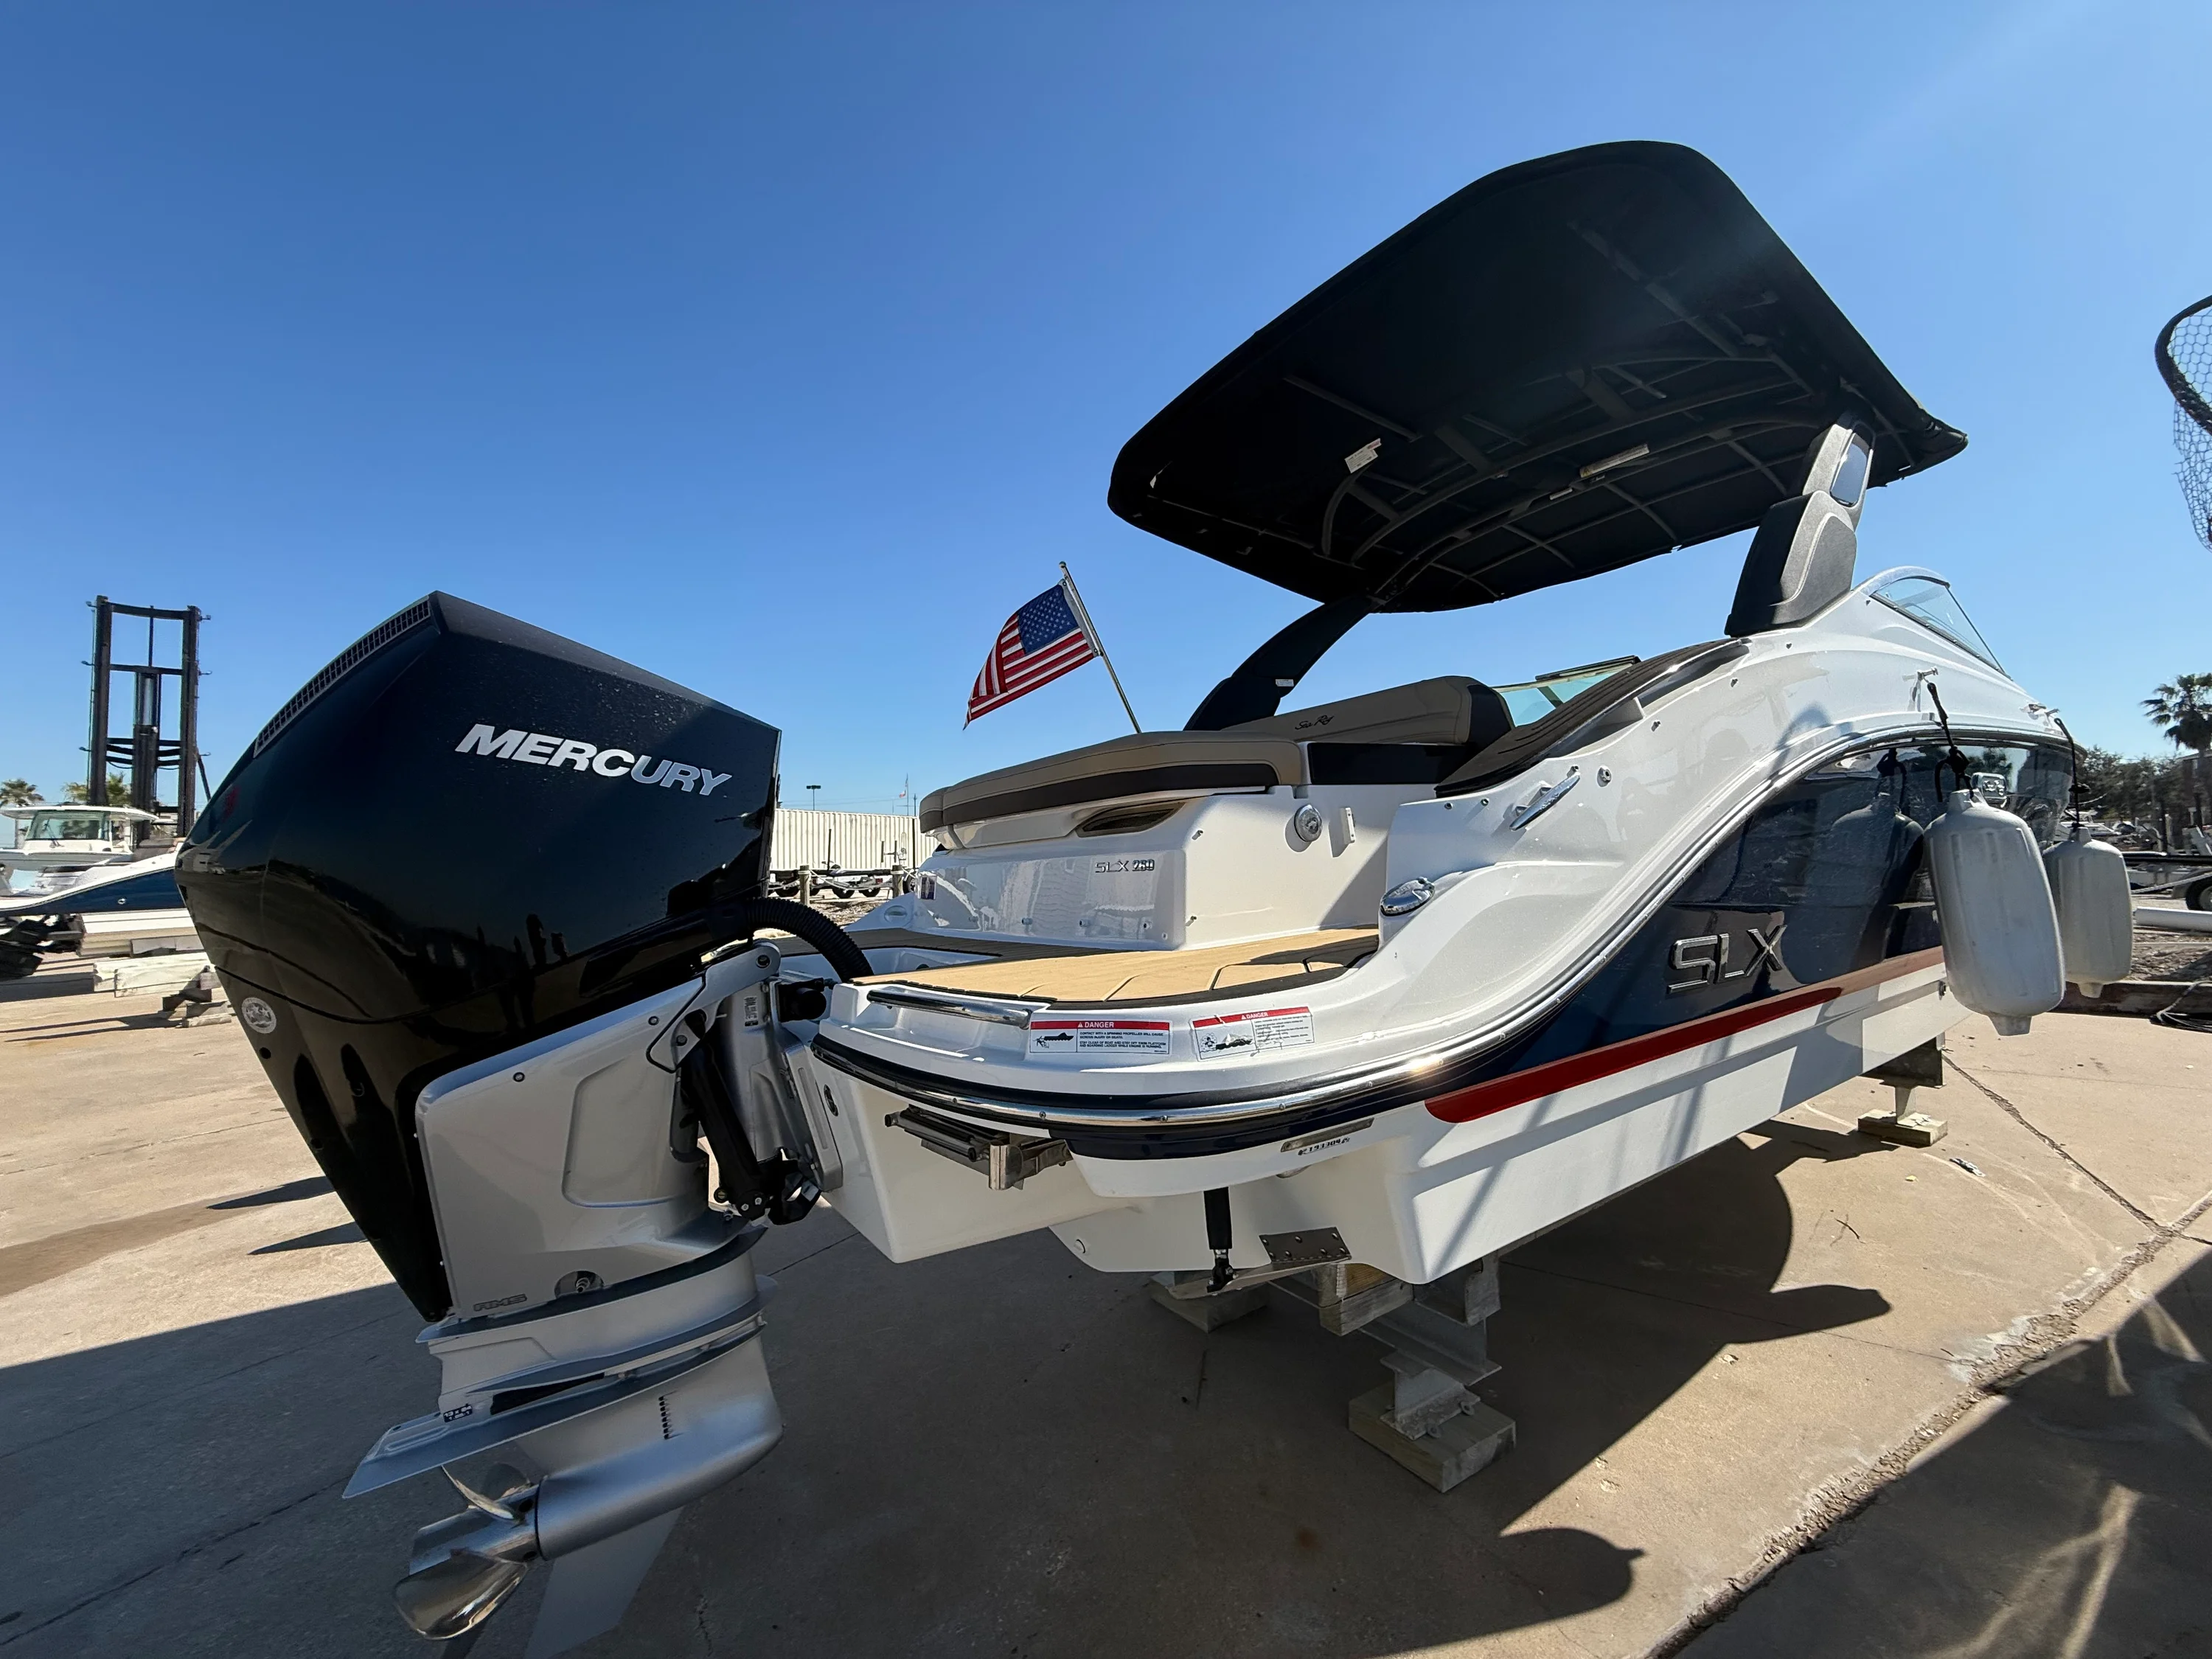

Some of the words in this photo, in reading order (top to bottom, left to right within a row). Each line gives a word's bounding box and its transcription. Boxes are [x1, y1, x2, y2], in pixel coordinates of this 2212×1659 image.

[1295, 720, 1313, 730] Sea
[454, 723, 732, 796] MERCURY
[1095, 859, 1130, 873] SLX
[1666, 924, 1787, 995] SLX
